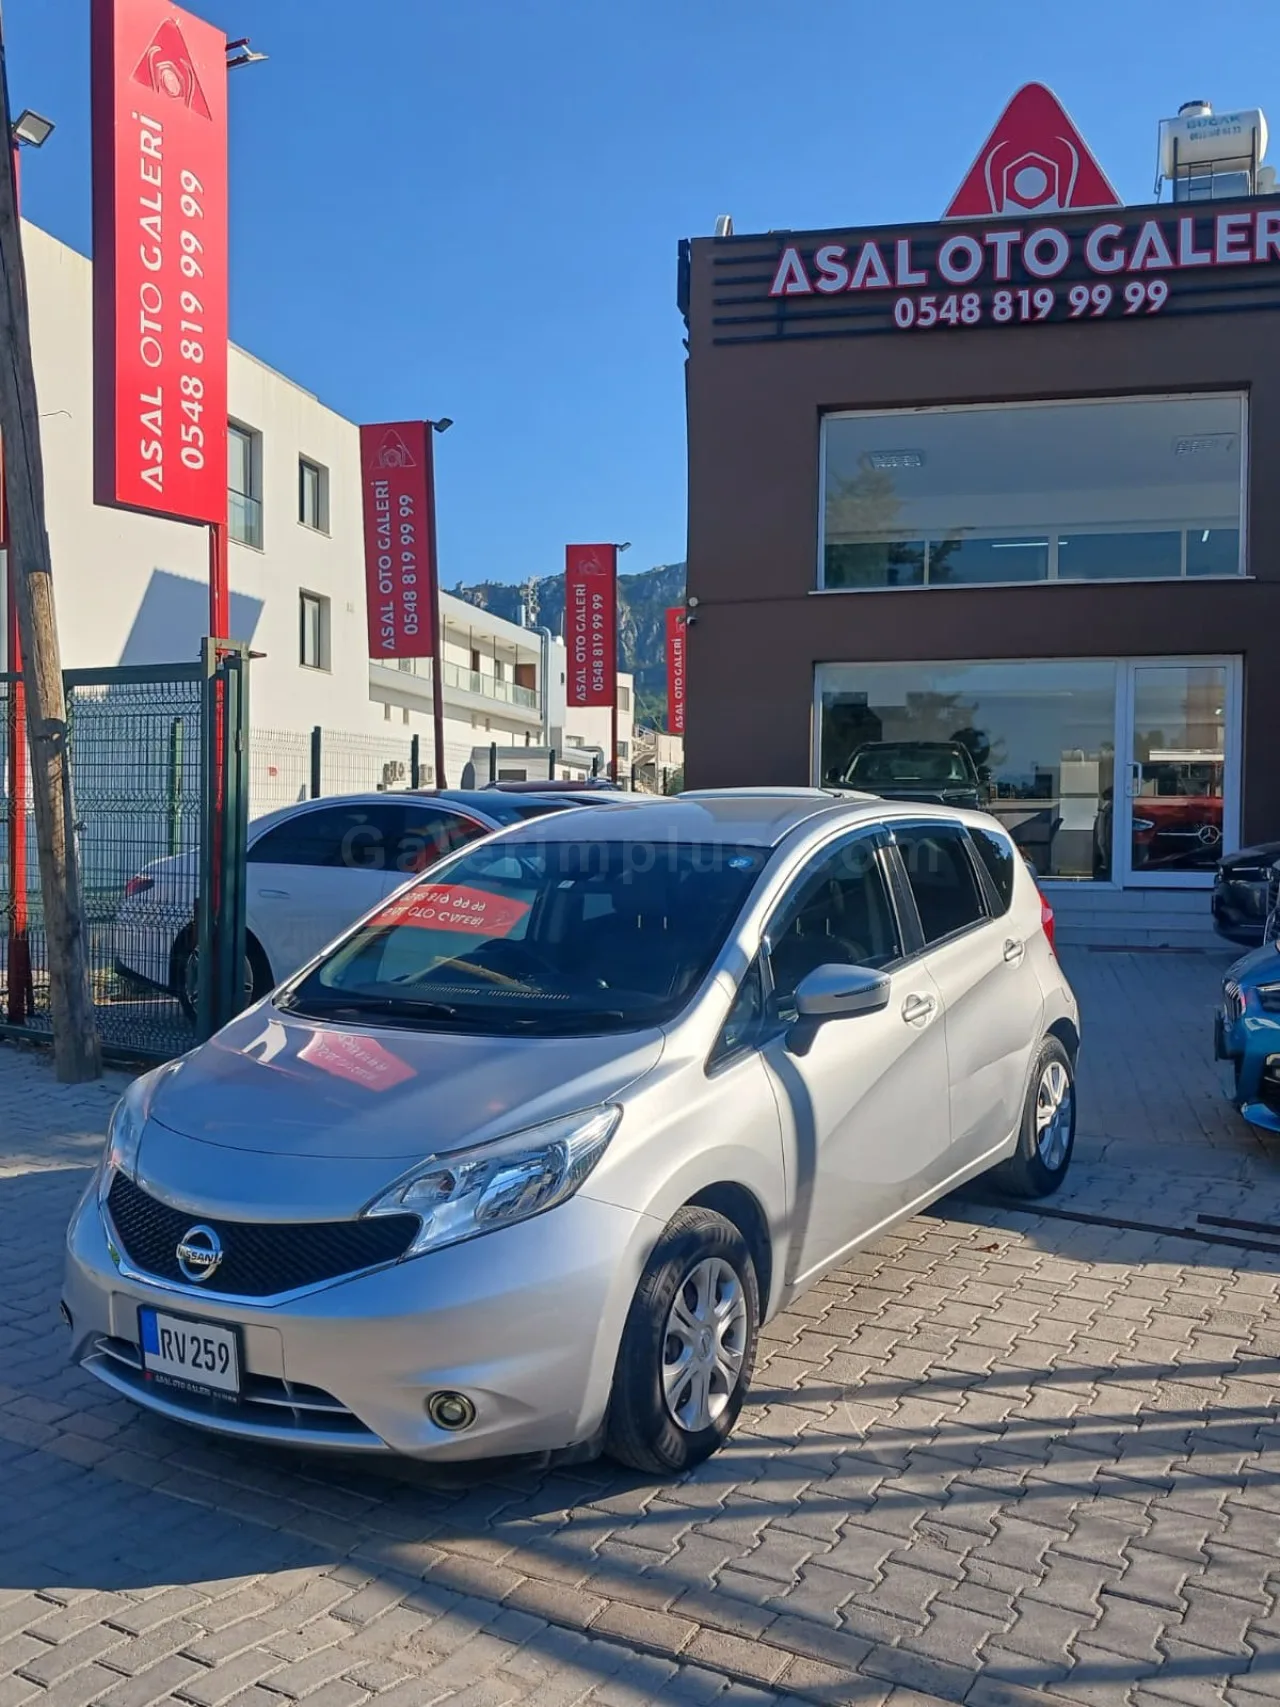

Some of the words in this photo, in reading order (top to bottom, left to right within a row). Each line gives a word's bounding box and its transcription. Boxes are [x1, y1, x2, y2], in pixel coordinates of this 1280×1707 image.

[131, 111, 163, 271] GALERİ
[180, 169, 204, 217] 99
[180, 230, 204, 278] 99
[771, 239, 927, 296] ASAL
[938, 227, 1070, 284] OTO
[894, 293, 981, 328] 0548
[992, 287, 1054, 322] 819
[1068, 283, 1112, 318] 99
[1124, 279, 1168, 315] 99
[140, 282, 163, 368] OTO
[180, 290, 204, 364] 819
[140, 386, 163, 493] ASAL
[180, 374, 204, 470] 0548
[371, 480, 391, 549] GALERİ
[399, 494, 414, 517] 99
[400, 523, 415, 545] 99
[378, 555, 393, 594] OTO
[401, 551, 417, 584] 819
[403, 590, 418, 635] 0548
[592, 594, 603, 610] 99
[592, 613, 603, 630] 99
[381, 601, 395, 649] ASAL
[592, 633, 603, 656] 819
[575, 635, 586, 662] OTO
[576, 667, 587, 701] ASAL
[593, 660, 603, 691] 0548
[674, 677, 683, 700] OTO
[675, 702, 684, 729] ASAL
[177, 1245, 216, 1263] NISSAN
